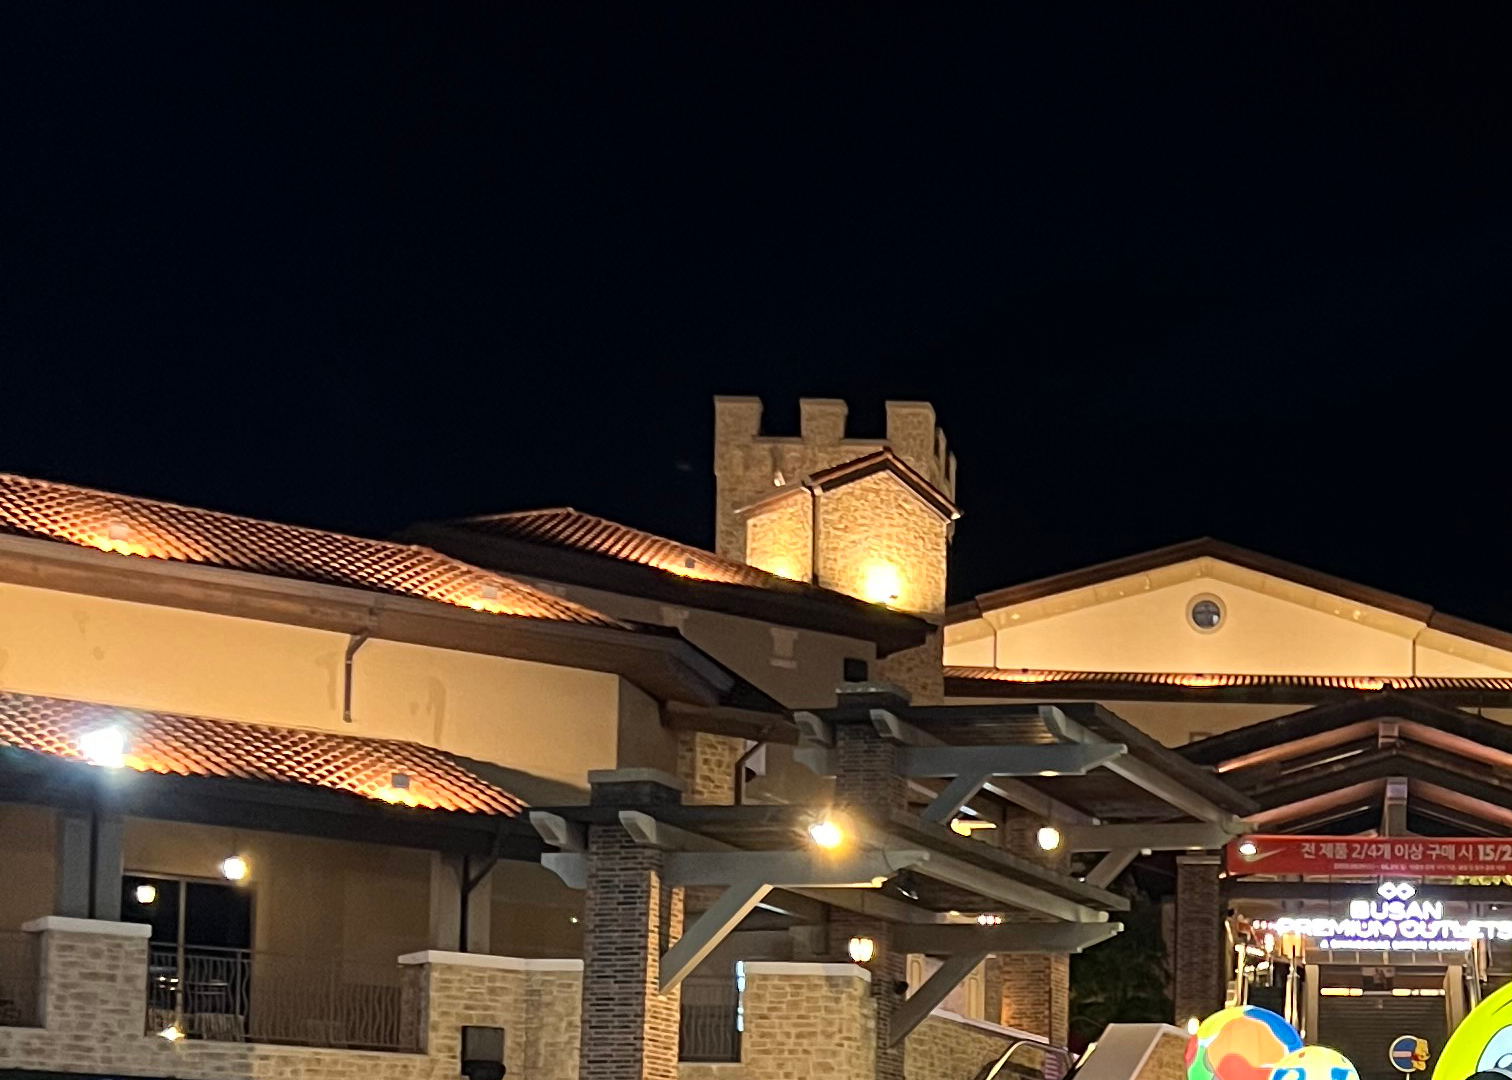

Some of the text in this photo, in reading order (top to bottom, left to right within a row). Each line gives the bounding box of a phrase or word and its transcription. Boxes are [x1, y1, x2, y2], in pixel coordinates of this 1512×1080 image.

[1301, 842, 1317, 859] 전
[1318, 842, 1349, 860] 제품
[1351, 842, 1392, 860] 2/4개
[1394, 842, 1424, 861] 이상
[1426, 844, 1456, 861] 구매
[1458, 844, 1474, 861] 시
[1350, 901, 1443, 920] BUSAN
[1277, 918, 1397, 938] PREMIUM
